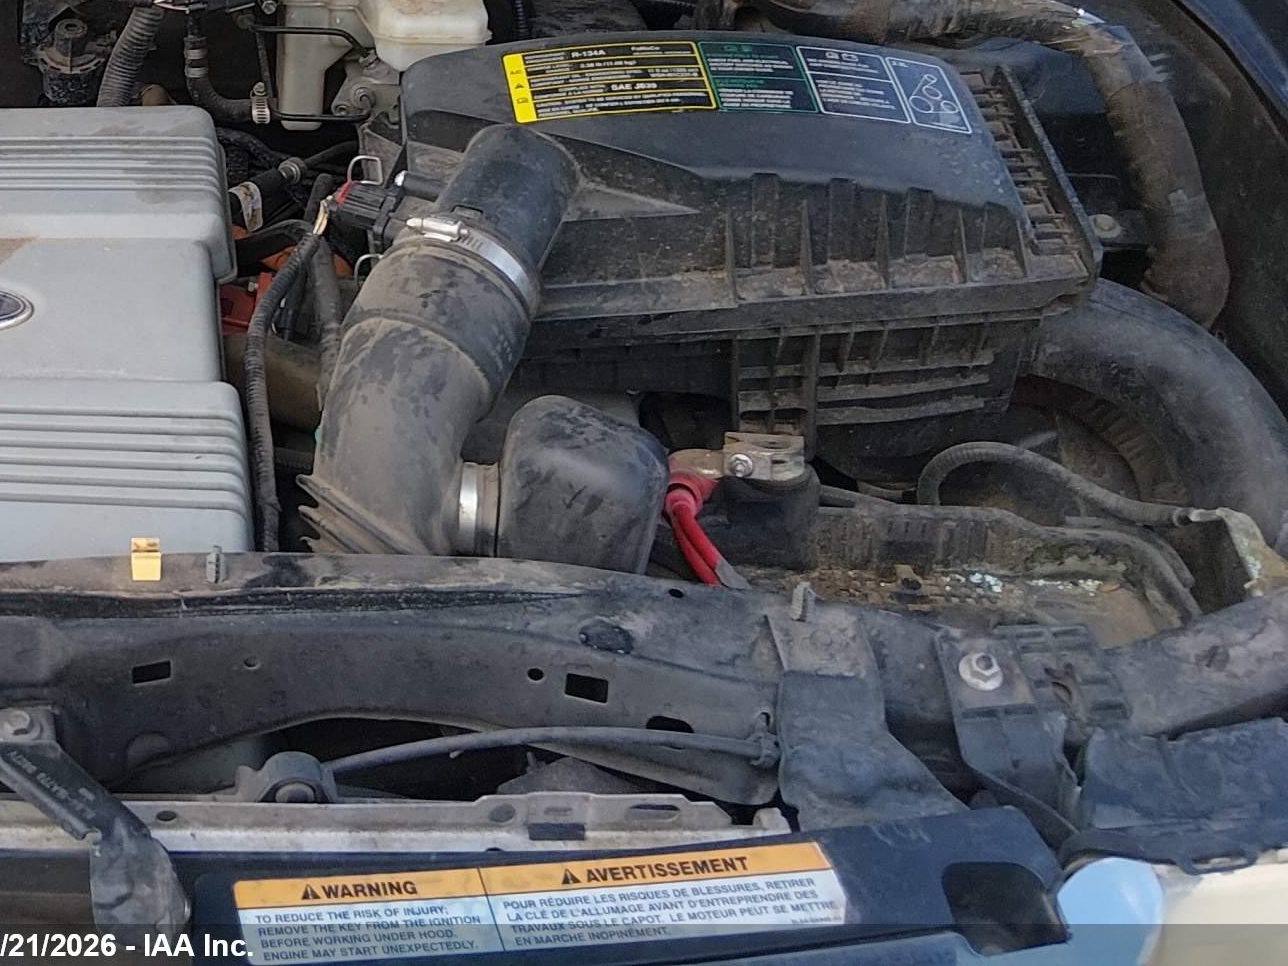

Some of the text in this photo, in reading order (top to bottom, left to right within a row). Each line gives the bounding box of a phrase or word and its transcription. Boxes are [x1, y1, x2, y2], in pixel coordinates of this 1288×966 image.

[571, 49, 606, 58] R-134A
[611, 83, 632, 91] SAE
[586, 856, 749, 883] AVERTISSEMENT
[321, 880, 418, 899] WARNING
[503, 900, 537, 910] POUR
[540, 894, 592, 908] RÉDUIRE
[594, 894, 617, 904] LES
[619, 889, 671, 902] RISQUES
[672, 888, 690, 898] DE
[766, 878, 816, 890] RETIRER
[255, 915, 272, 924] TO
[275, 912, 324, 924] REDUCE
[327, 910, 351, 921] THE
[354, 909, 381, 919] RISK
[384, 908, 401, 917] OF
[506, 890, 819, 922] LA CLÉ DE L'ALLUMAGE AVANT D'ENTREPRENDRE DES
[258, 916, 481, 937] REMOVE THE KEY FROM THE IGNITION
[510, 923, 566, 934] TRAVAUX
[568, 920, 602, 930] SOUS
[604, 919, 619, 928] LE
[670, 912, 686, 923] LE
[688, 908, 738, 922] MOTEUR
[740, 906, 770, 917] PEUT
[772, 904, 788, 915] SE
[260, 936, 311, 949] BEFORE
[312, 934, 372, 946] WORKING
[374, 931, 416, 943] UNDER
[514, 936, 532, 946] EN
[534, 932, 586, 945] MARCHE
[263, 940, 479, 962] ENGINE MAY START UNEXPECTEDLY.
